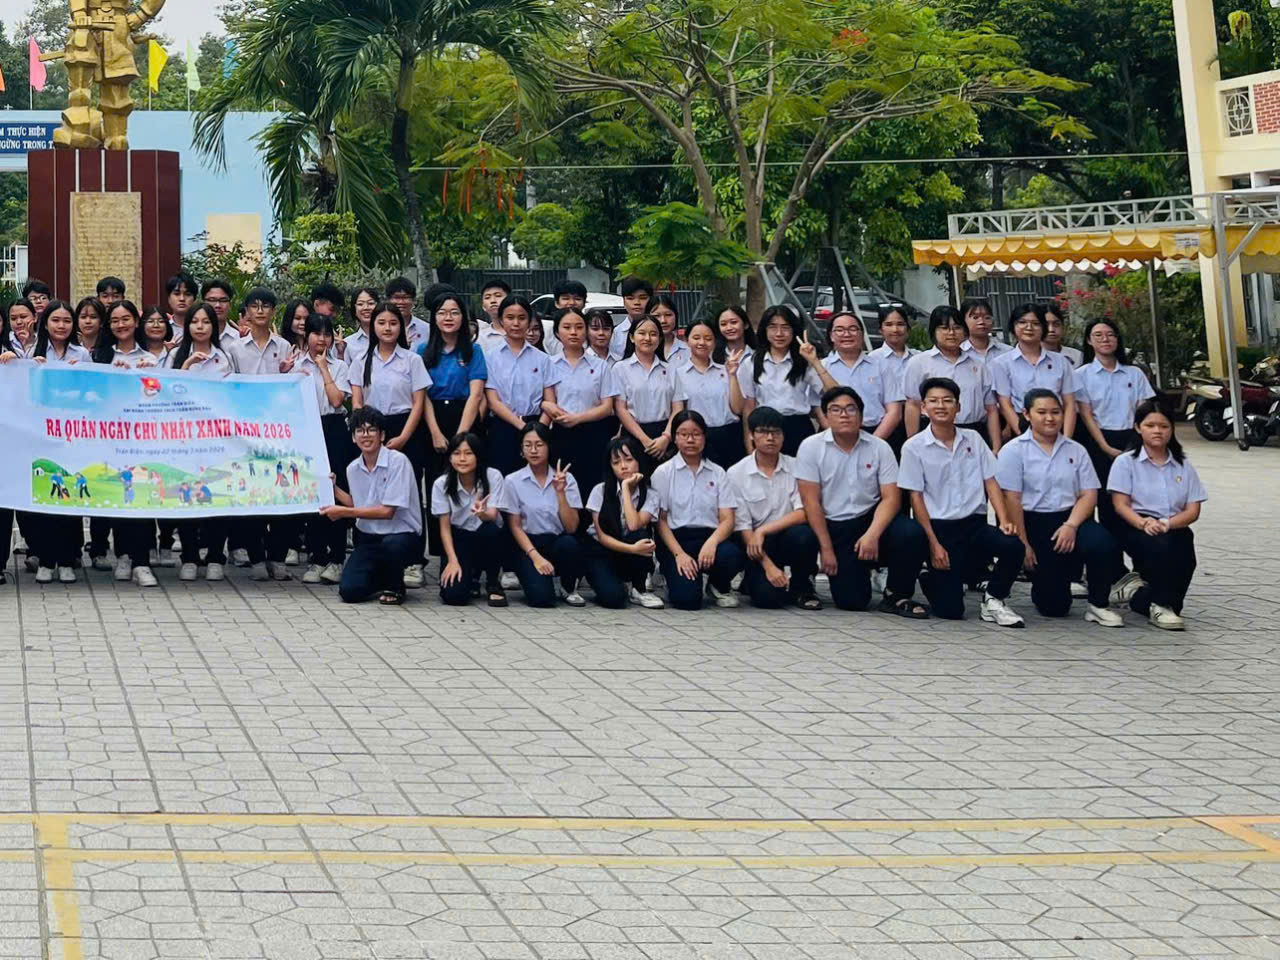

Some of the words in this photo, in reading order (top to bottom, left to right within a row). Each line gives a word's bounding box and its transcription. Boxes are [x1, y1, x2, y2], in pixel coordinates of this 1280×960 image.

[7, 126, 27, 138] THỰC
[28, 125, 46, 138] HIỆN
[23, 140, 46, 149] TRONG
[46, 418, 62, 437] RA
[65, 416, 96, 443] QUÂN
[99, 416, 131, 439] NGÀY
[134, 416, 158, 440] CHỦ
[161, 416, 193, 444] NHẬT
[196, 418, 232, 438] XANH
[234, 419, 261, 438] NĂM
[263, 423, 292, 439] 2026
